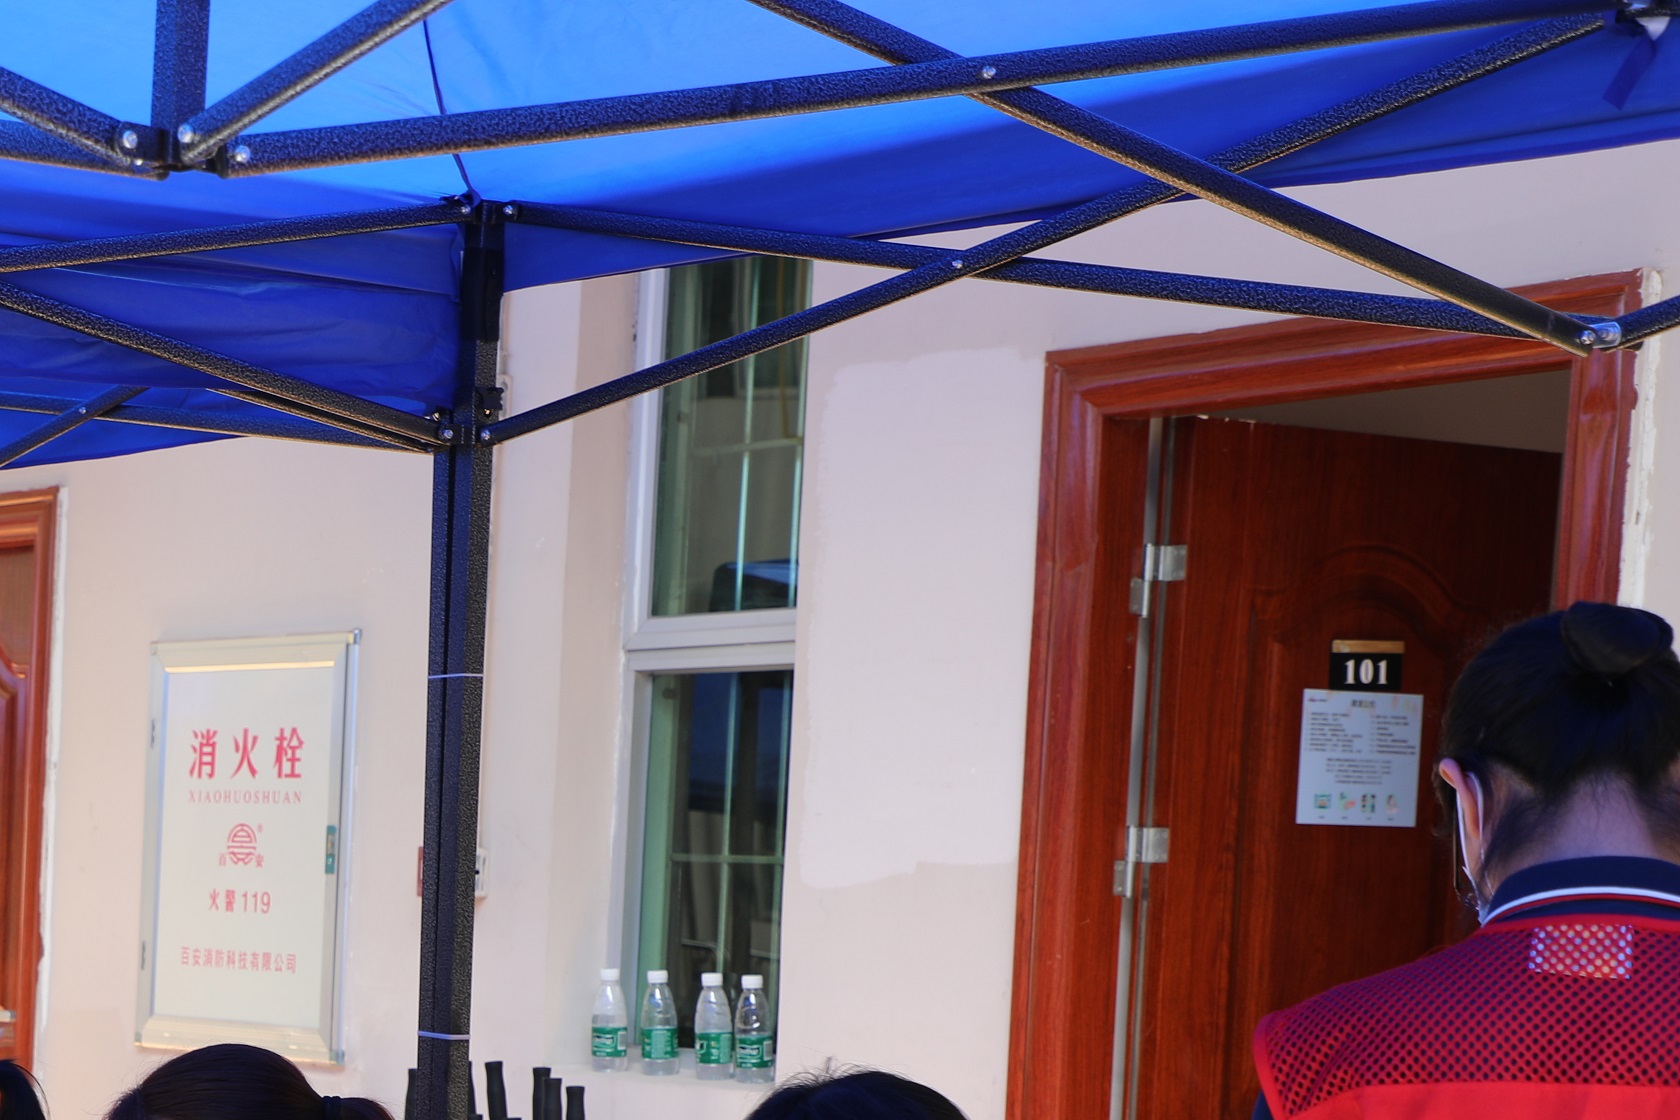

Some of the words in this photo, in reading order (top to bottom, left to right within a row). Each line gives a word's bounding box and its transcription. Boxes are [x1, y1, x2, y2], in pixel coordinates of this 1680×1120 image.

[1344, 658, 1388, 685] 101
[189, 727, 305, 780] 消火栓
[188, 789, 303, 805] XIAOHUOSHUAN
[180, 946, 297, 974] 百安消防科技有限公司
